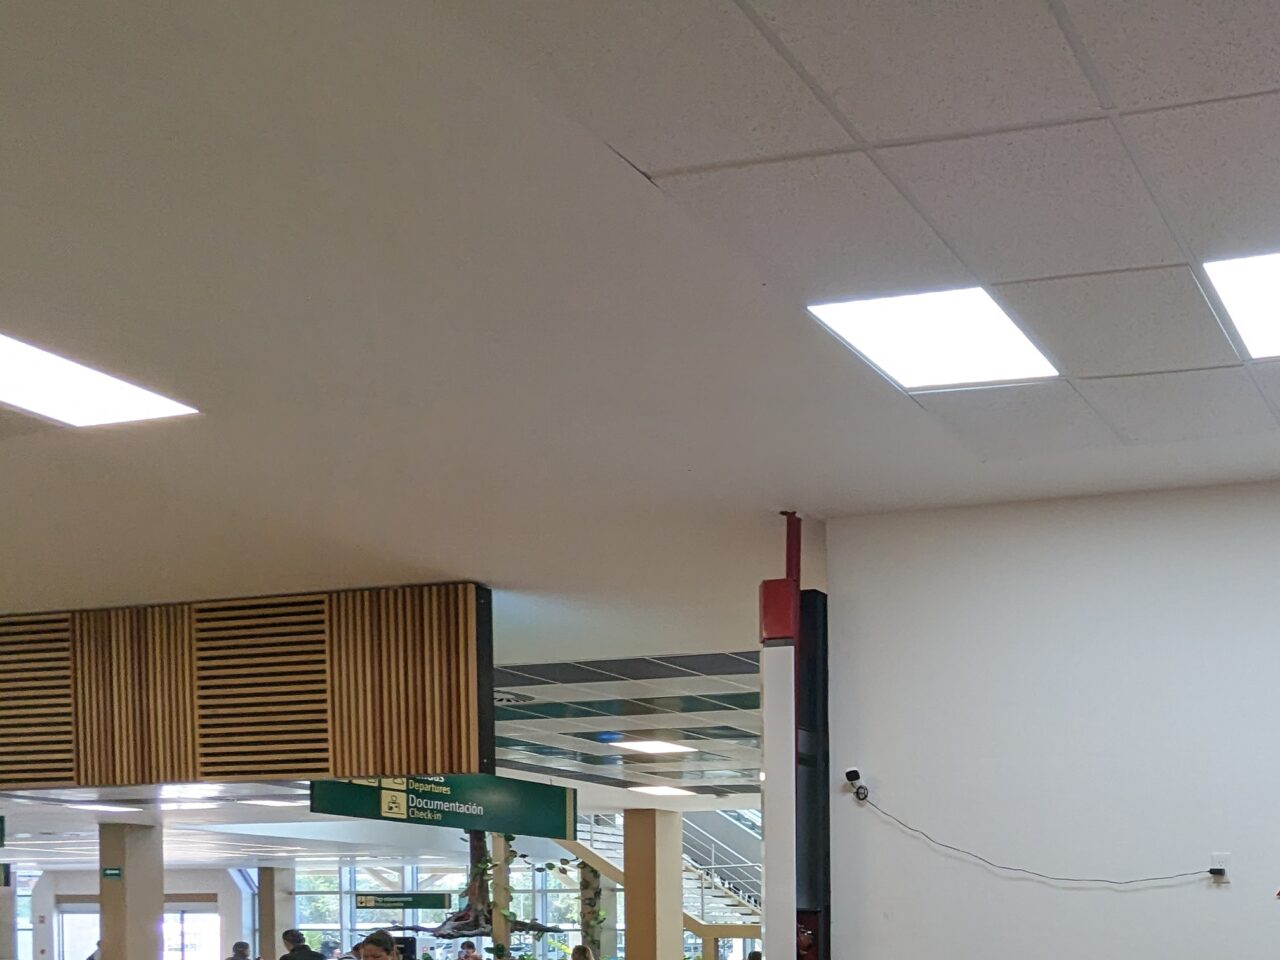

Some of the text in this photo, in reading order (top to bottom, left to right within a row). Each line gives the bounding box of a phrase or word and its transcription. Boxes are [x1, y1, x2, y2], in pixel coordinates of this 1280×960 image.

[409, 780, 450, 794] Departures
[409, 795, 483, 815] Documentación
[409, 808, 441, 820] Check-in
